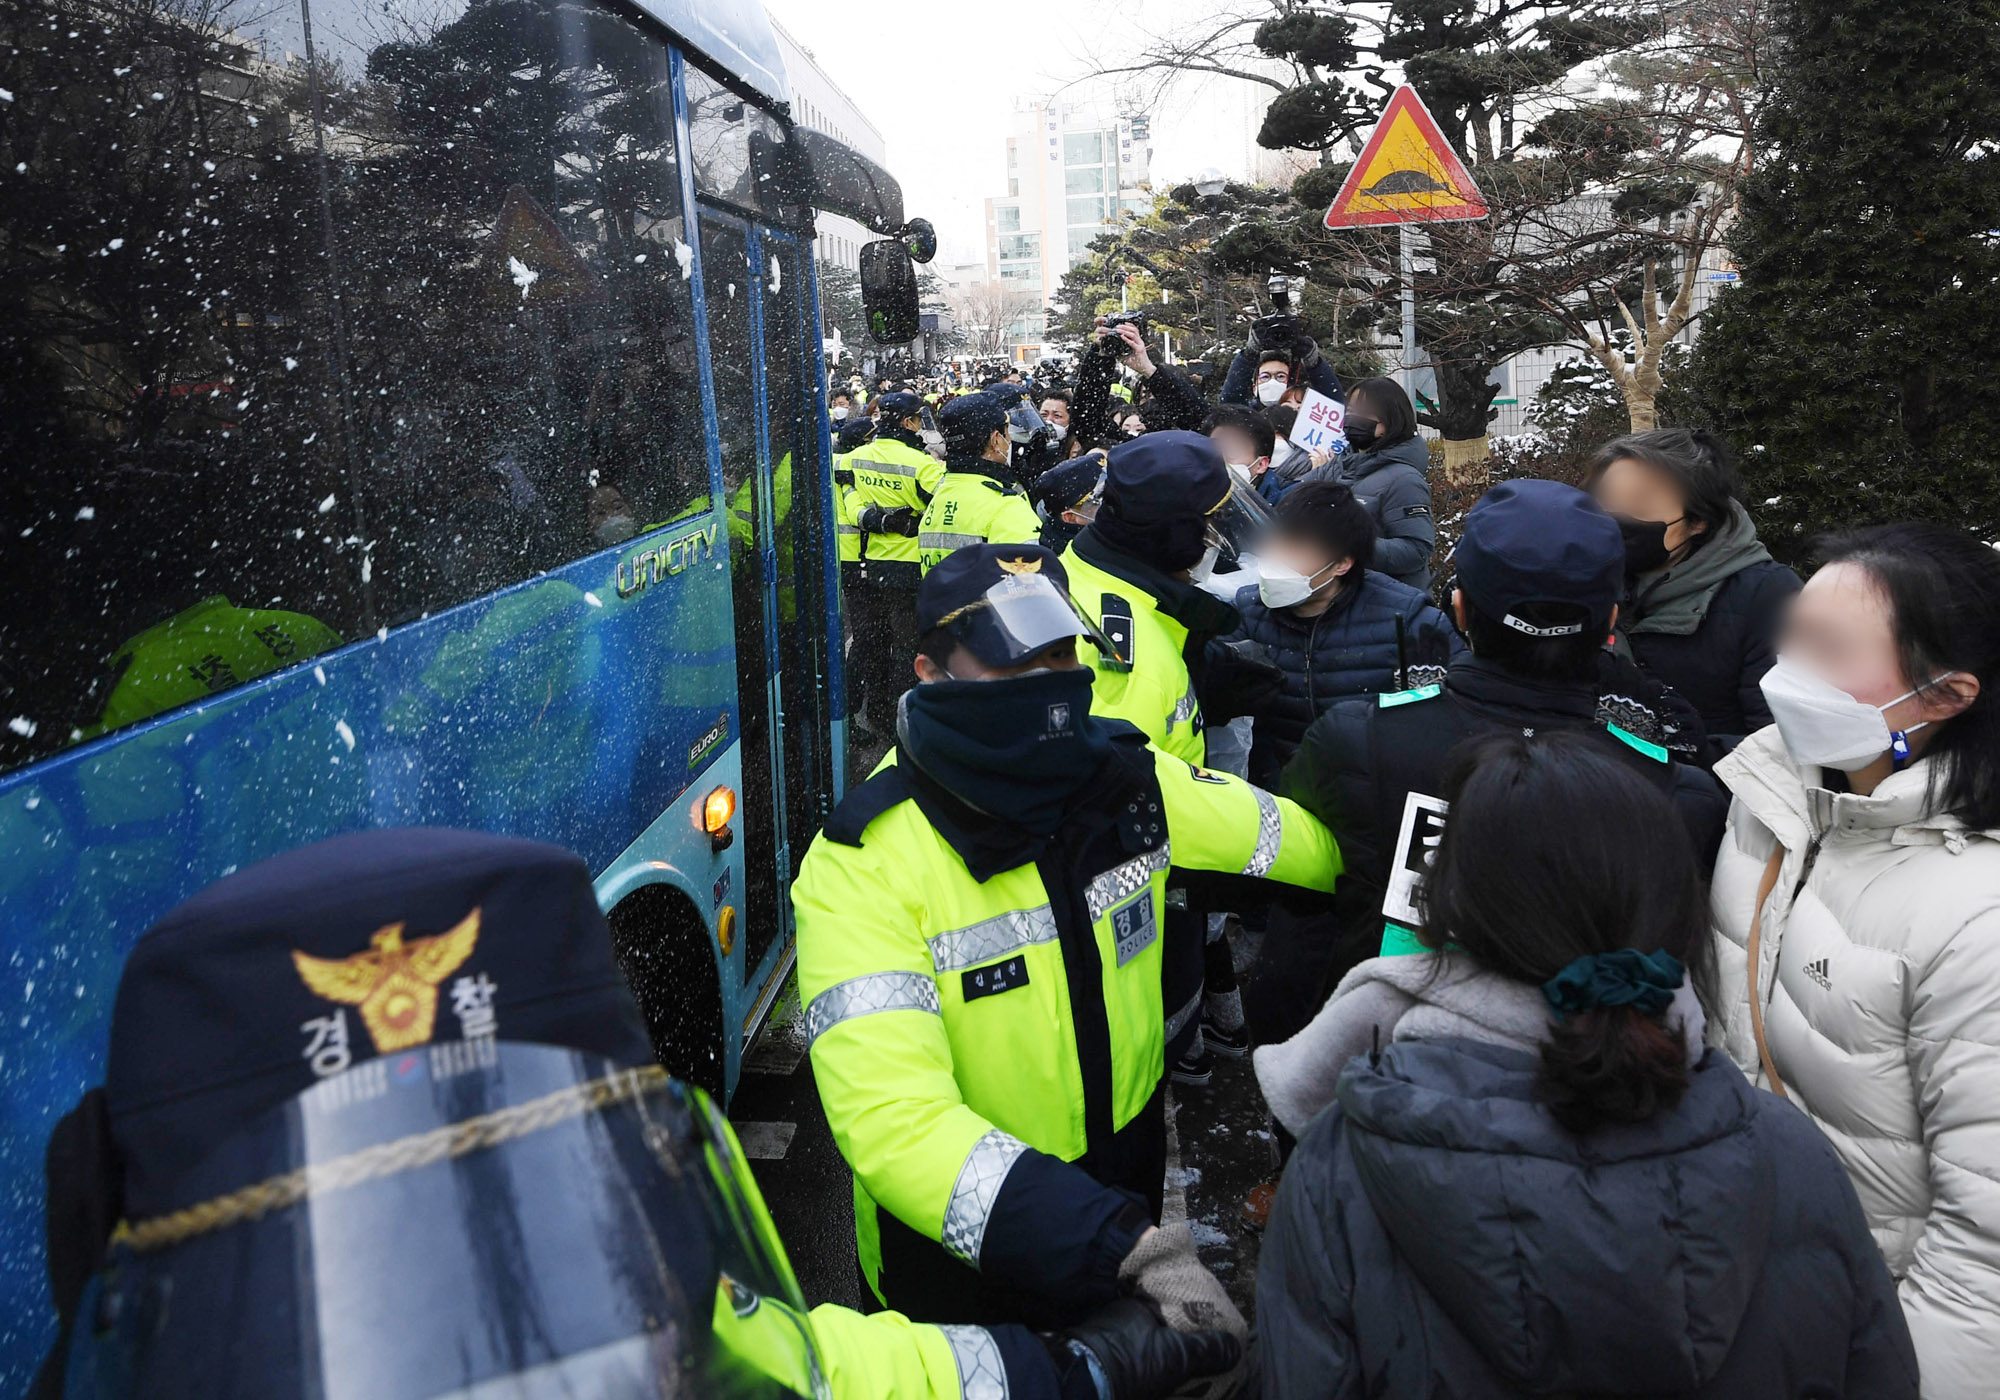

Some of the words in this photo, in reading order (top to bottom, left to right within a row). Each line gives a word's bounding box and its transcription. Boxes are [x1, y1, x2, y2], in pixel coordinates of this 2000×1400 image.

[1309, 401, 1345, 433] 살인
[691, 728, 718, 760] EURO
[1116, 897, 1150, 938] 경찰
[1120, 925, 1153, 957] POLICE
[1803, 965, 1832, 991] adidas
